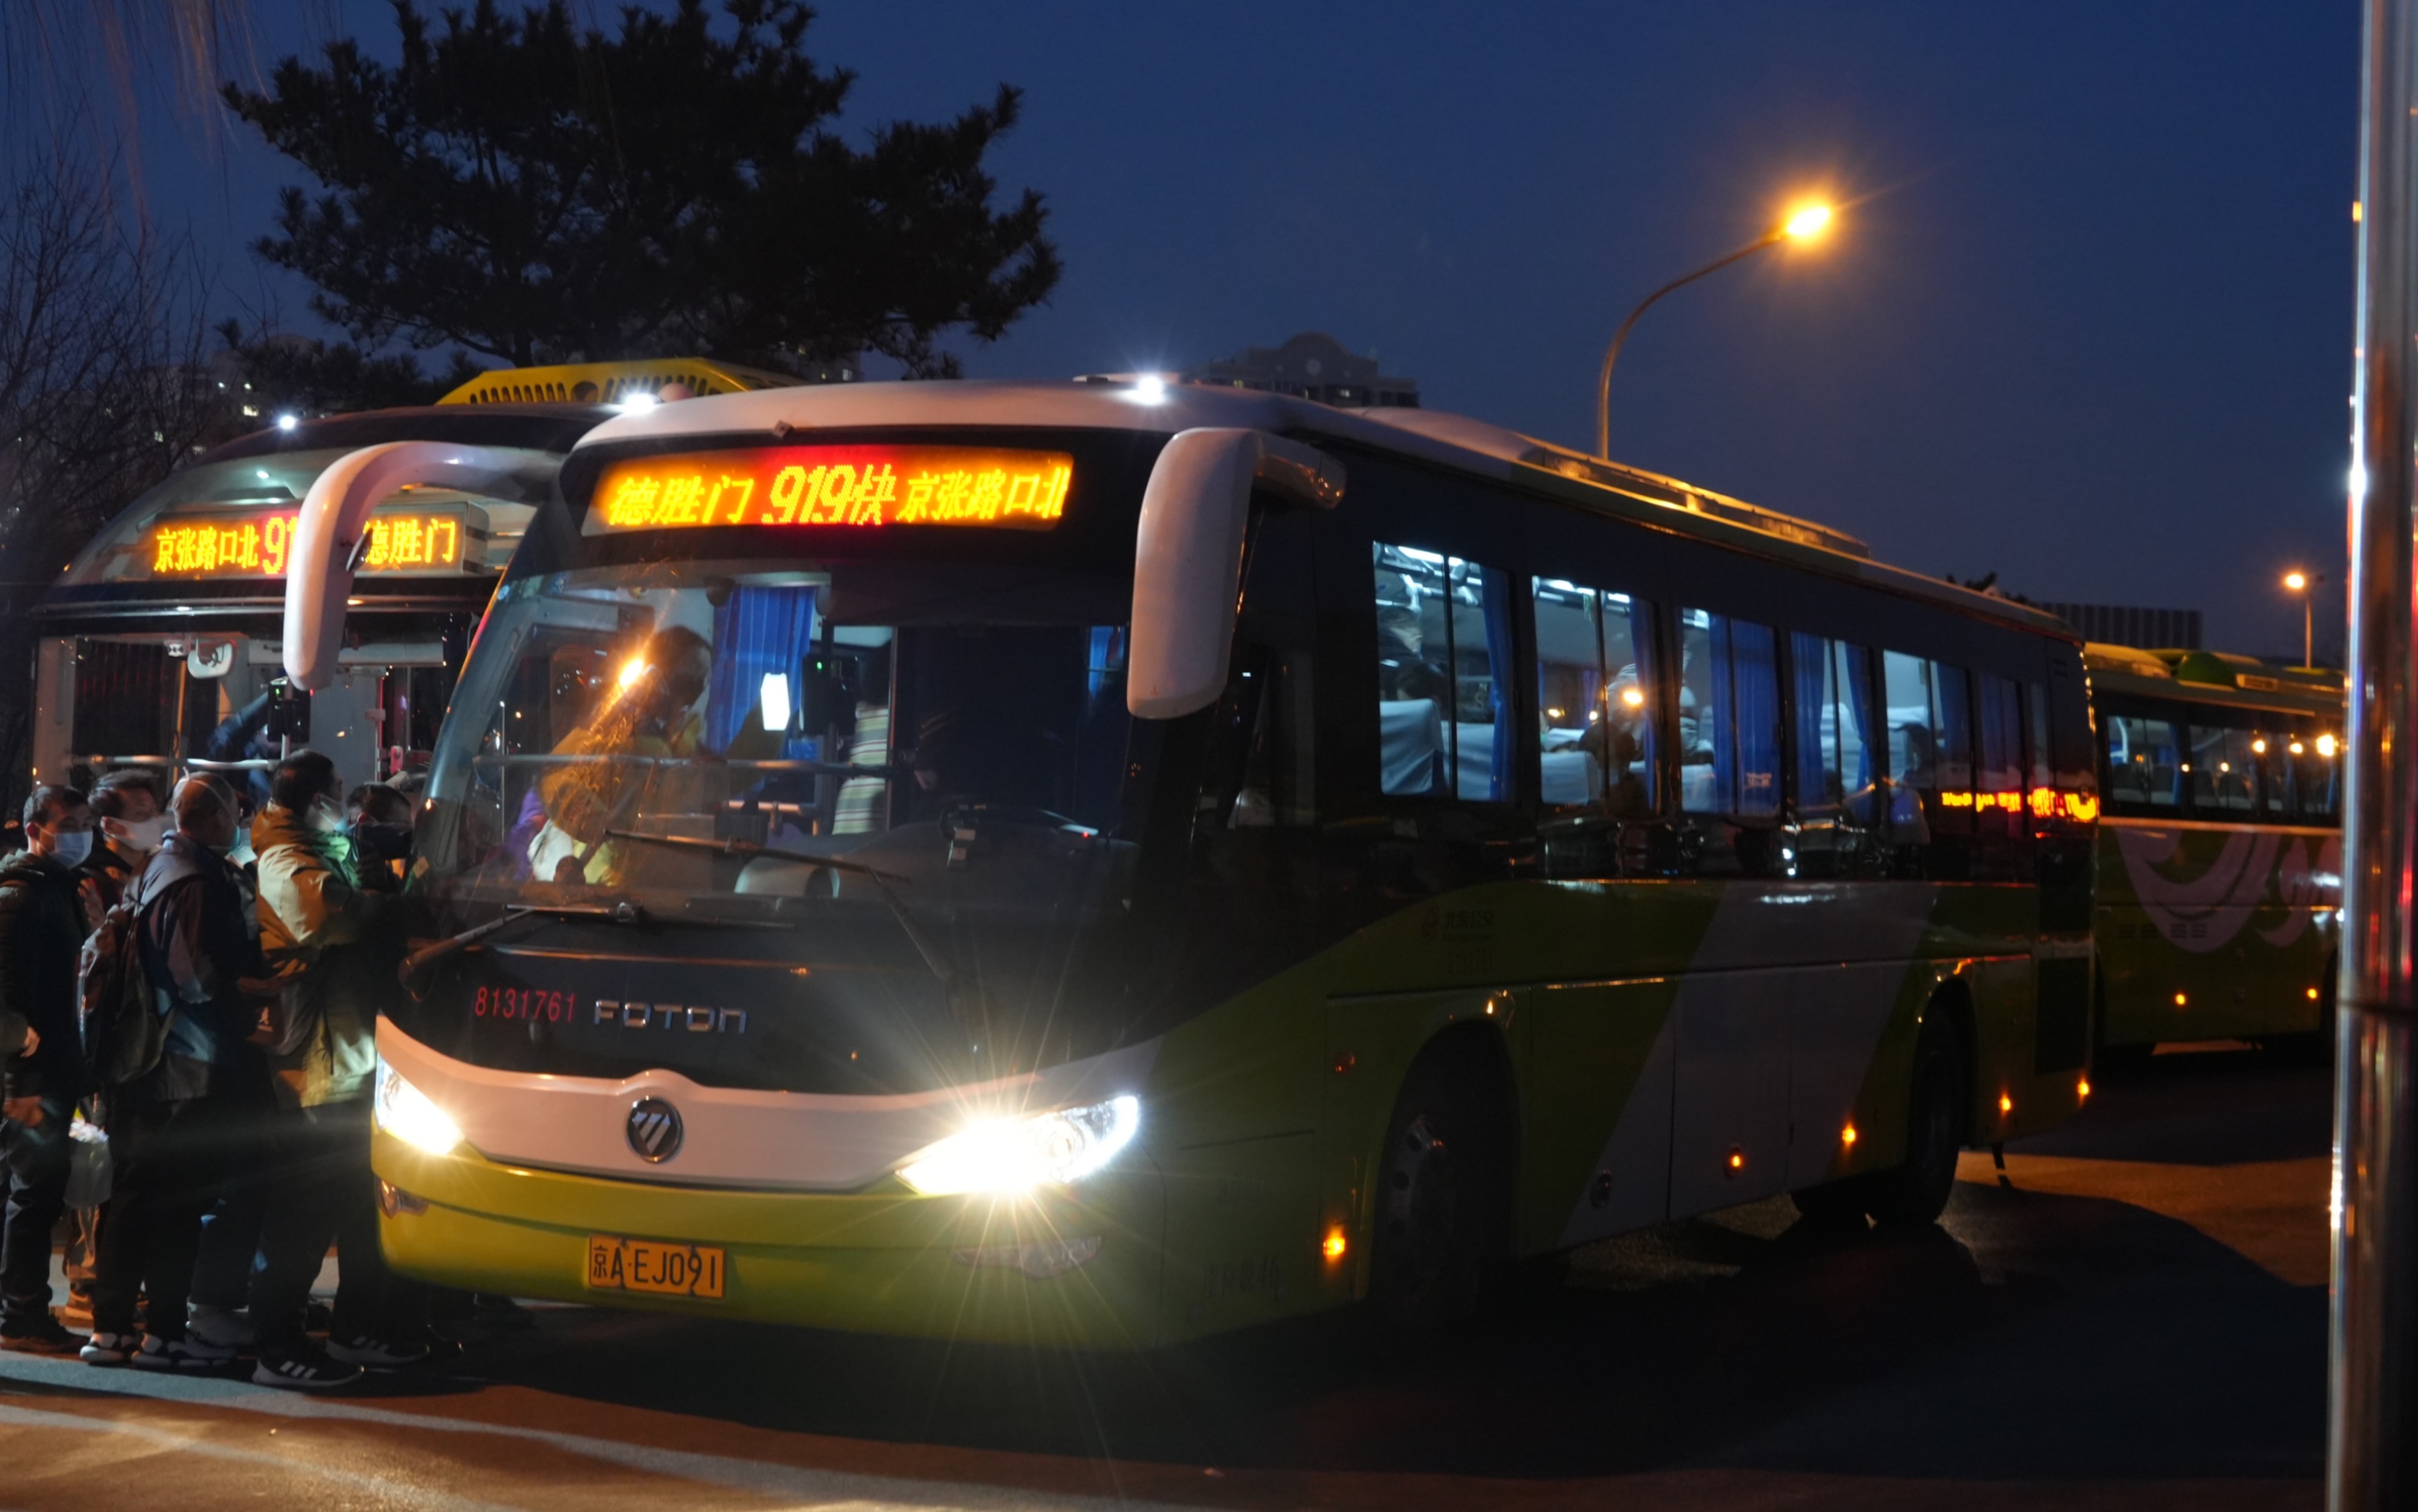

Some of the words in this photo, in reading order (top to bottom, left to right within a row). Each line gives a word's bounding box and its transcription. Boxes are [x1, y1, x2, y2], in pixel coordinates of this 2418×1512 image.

[609, 476, 754, 525] 德胜门
[896, 467, 1070, 523] 京张路口北
[154, 526, 259, 572] 京张路口北
[474, 987, 576, 1022] 8131761
[594, 1000, 747, 1033] FOTON
